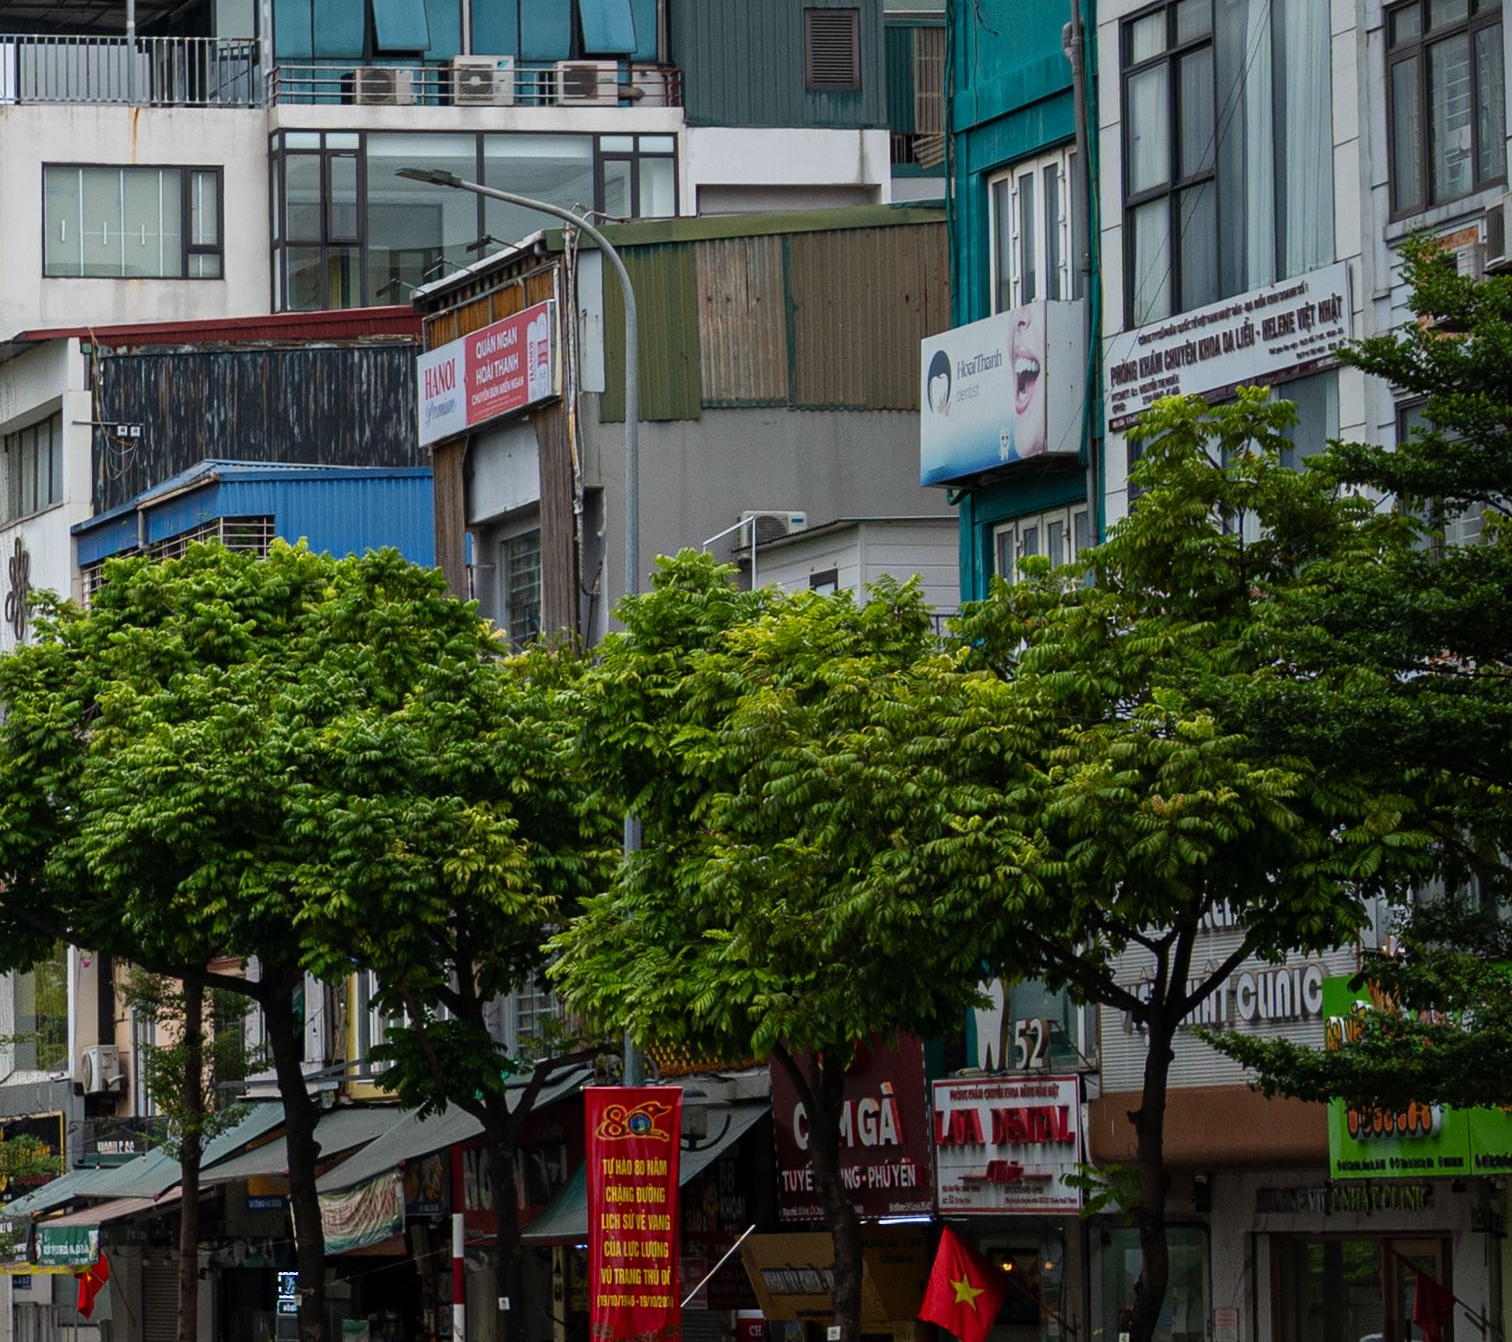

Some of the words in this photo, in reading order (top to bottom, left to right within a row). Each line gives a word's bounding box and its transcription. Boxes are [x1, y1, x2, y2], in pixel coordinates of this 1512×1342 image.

[475, 332, 496, 359] QUÁN
[497, 326, 518, 350] NGAN
[1111, 358, 1138, 387] PHÒNG
[1139, 349, 1163, 379] KHÁM
[1198, 333, 1222, 362] KHOA
[1223, 329, 1235, 354] DA
[1262, 311, 1295, 342] HELENE
[1296, 301, 1316, 333] VIỆT
[1318, 292, 1343, 324] NHẬT
[424, 357, 456, 401] HANOI
[475, 358, 494, 387] HOÀI
[494, 353, 519, 377] THANH
[1015, 1018, 1043, 1070] 52
[793, 1099, 855, 1151] CM
[857, 1081, 901, 1147] GÀ
[602, 1158, 615, 1179] TỰ
[615, 1158, 633, 1176] HÀO
[634, 1159, 645, 1176] 80
[647, 1158, 668, 1176] NĂM
[781, 1160, 816, 1192] TUYẾ
[605, 1185, 635, 1208] CHẶNG
[636, 1185, 666, 1204] ĐƯỜNG
[601, 1213, 621, 1235] LỊCH
[648, 1214, 671, 1232] VANG
[603, 1237, 622, 1258] CỦA
[622, 1239, 640, 1261] LỰC
[640, 1240, 669, 1263] LƯỢNG
[614, 1267, 642, 1286] TRANG
